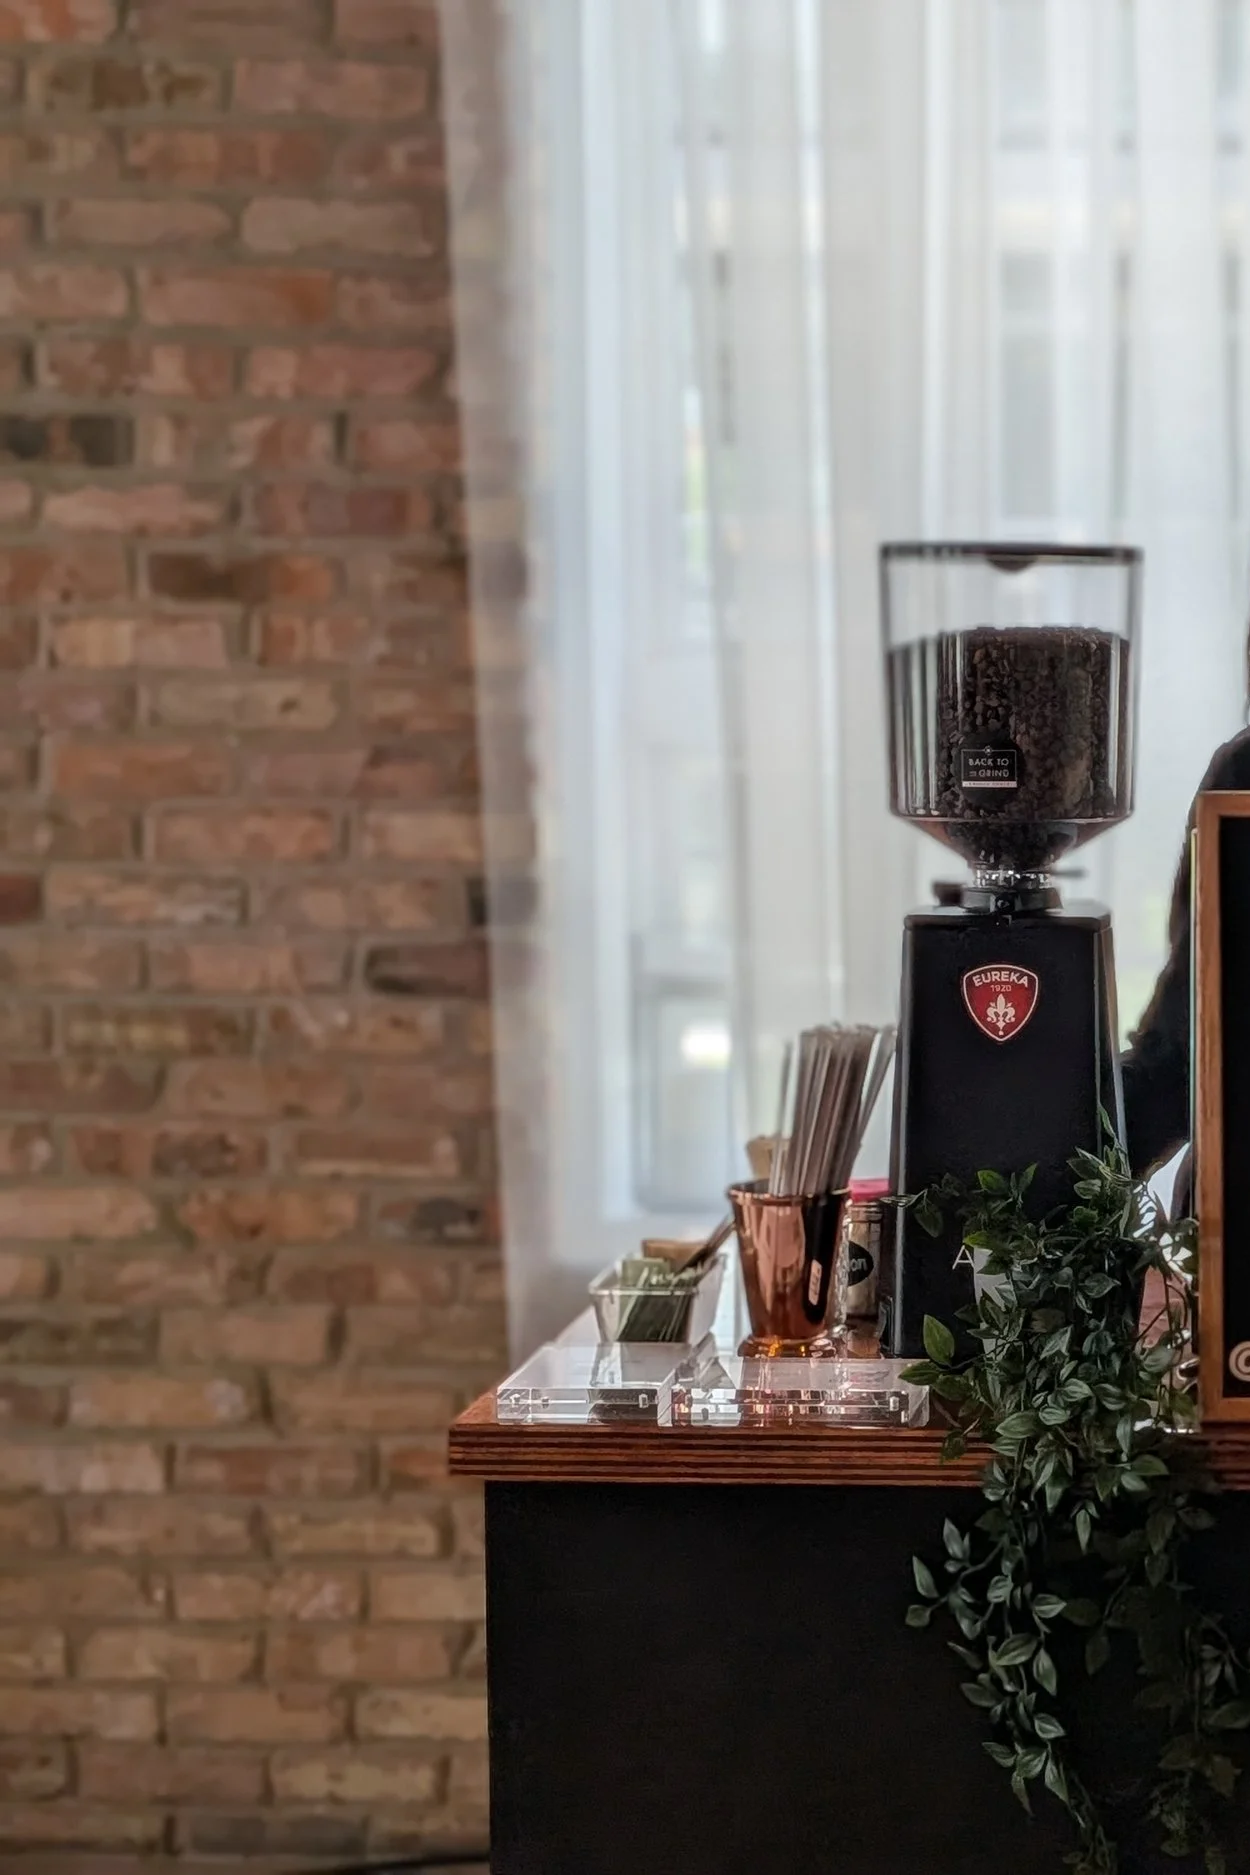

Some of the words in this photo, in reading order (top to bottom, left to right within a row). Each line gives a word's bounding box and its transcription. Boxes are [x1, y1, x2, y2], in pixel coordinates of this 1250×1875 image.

[968, 758, 993, 766] BACK
[997, 758, 1009, 766] TO
[972, 971, 1029, 988] EUREKA
[990, 984, 1012, 992] 1920
